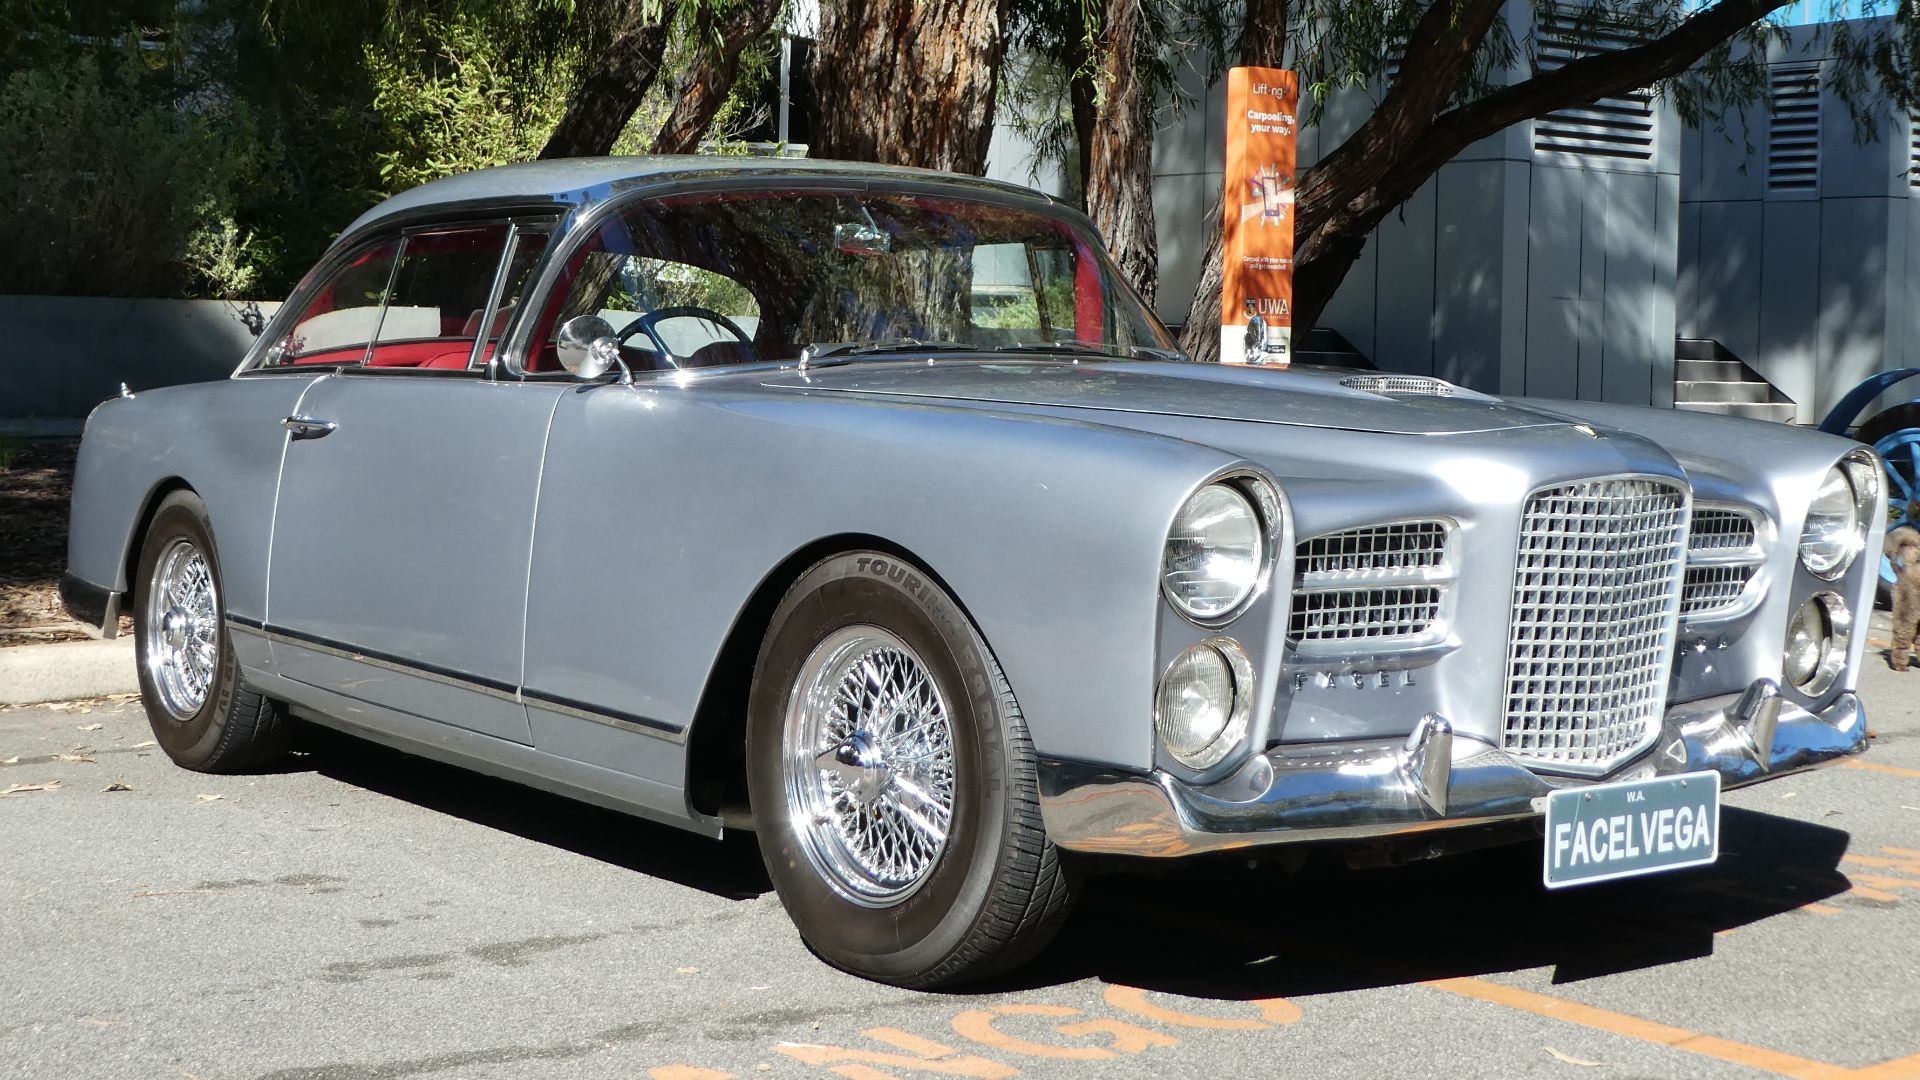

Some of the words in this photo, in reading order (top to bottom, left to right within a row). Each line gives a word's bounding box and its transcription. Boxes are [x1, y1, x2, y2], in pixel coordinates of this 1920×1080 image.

[1247, 109, 1295, 124] Carpooling,
[1250, 123, 1271, 134] your
[1272, 125, 1291, 136] way.
[1258, 298, 1290, 315] UWA
[1295, 669, 1416, 691] FACEL
[1626, 790, 1646, 803] W.A.
[1554, 804, 1711, 869] FACELVEGA
